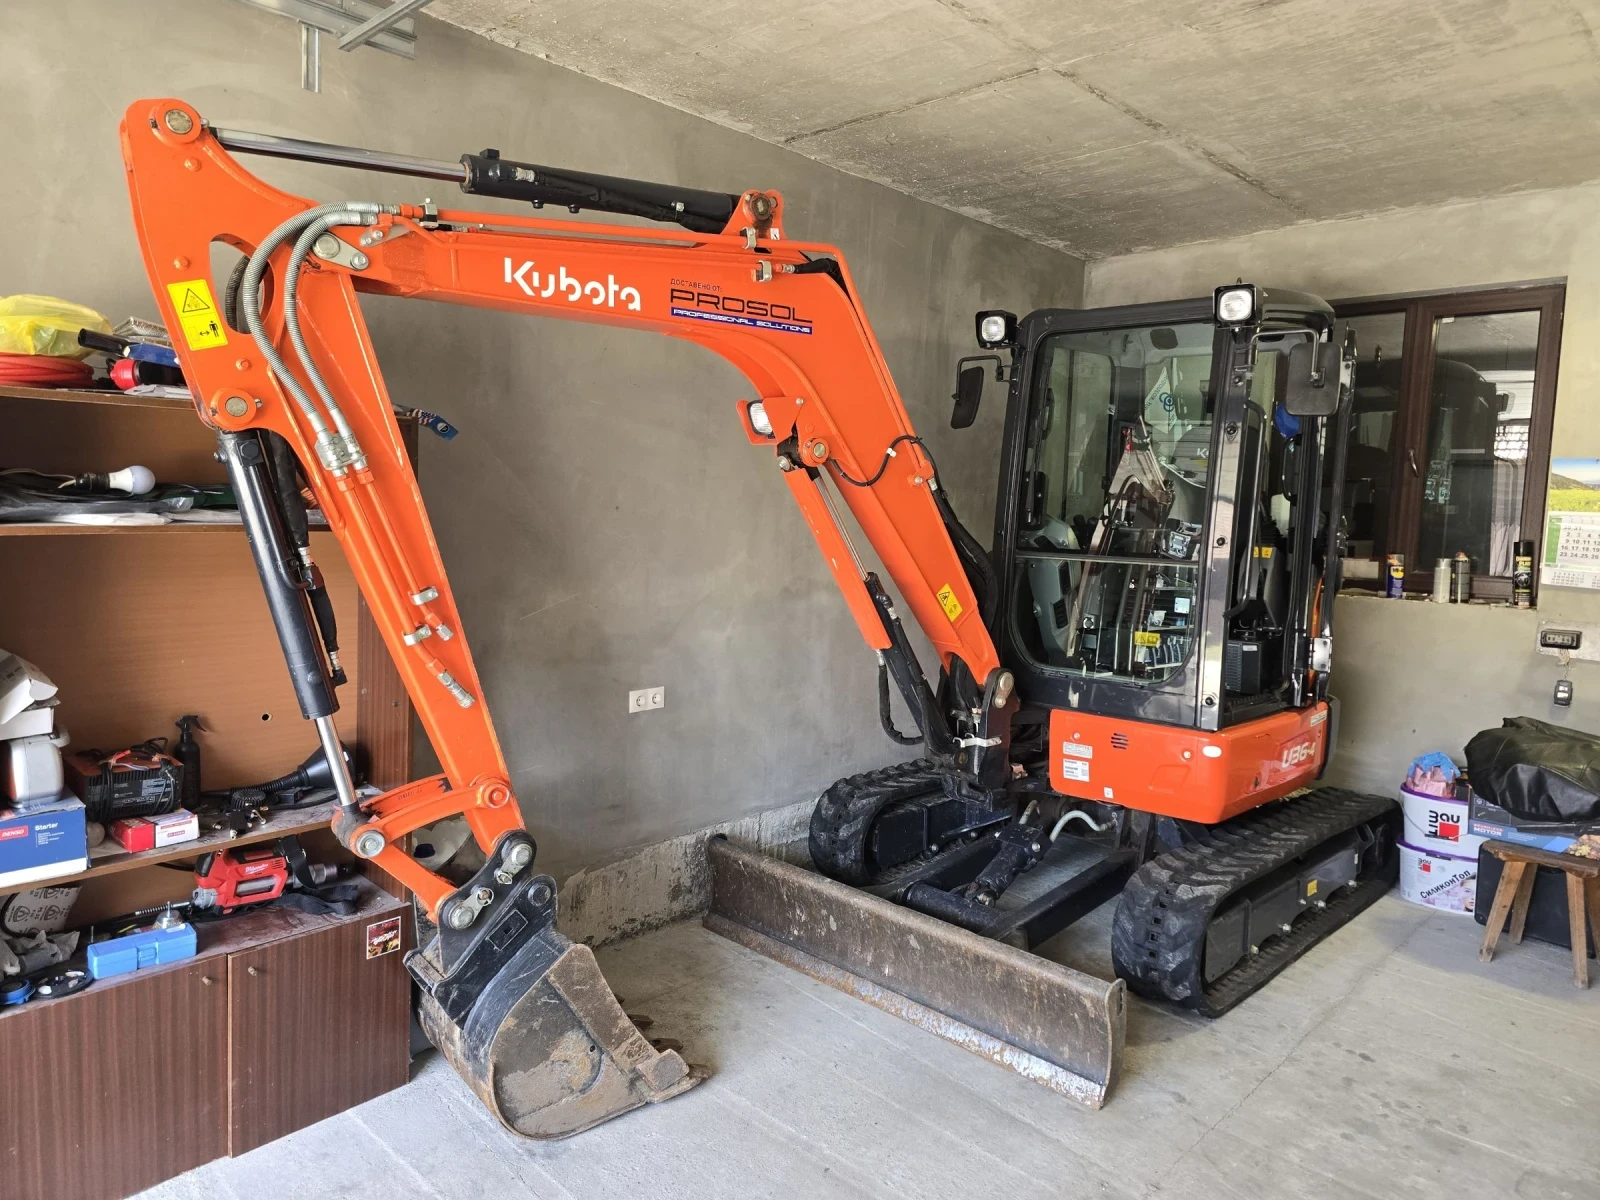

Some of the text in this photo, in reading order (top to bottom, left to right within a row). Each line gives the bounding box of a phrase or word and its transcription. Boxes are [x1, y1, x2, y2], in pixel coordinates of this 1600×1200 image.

[504, 257, 641, 311] Kubota
[670, 278, 723, 293] ДОСТАВЕНО ОТ:
[670, 288, 813, 324] PROSOL
[673, 308, 811, 333] PROFESSIONAL SOLUTIONS
[1281, 741, 1316, 768] U36-4
[35, 822, 59, 831] Starter
[1473, 827, 1502, 837] MOTOR
[1420, 870, 1471, 899] СиликонТоп
